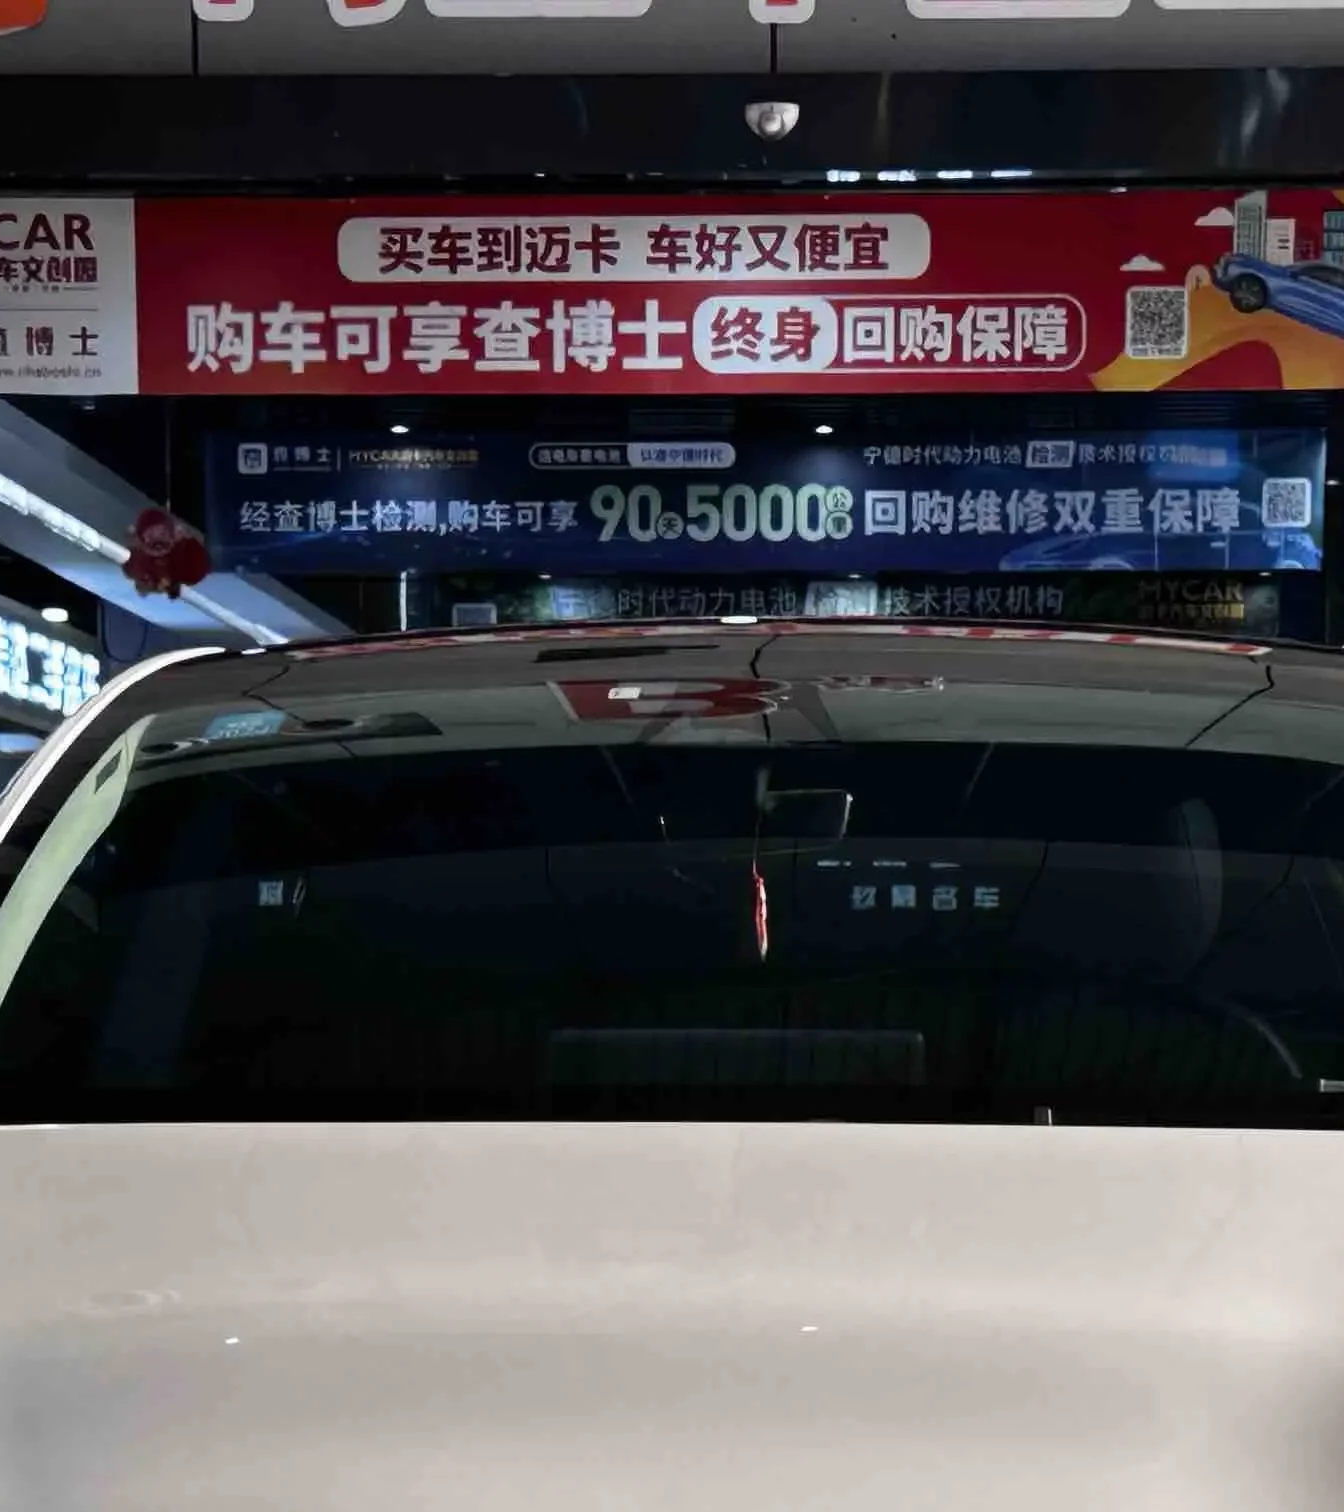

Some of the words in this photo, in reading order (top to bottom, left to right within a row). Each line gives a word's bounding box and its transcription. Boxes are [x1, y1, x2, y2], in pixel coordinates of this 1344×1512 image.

[378, 223, 621, 275] 买车到迈卡
[645, 222, 890, 273] 车好又便宜
[186, 298, 688, 374] 购车可享查博士
[709, 304, 821, 364] 终身
[842, 303, 1070, 365] 回购保障
[863, 489, 1243, 535] 回购维修双重保障
